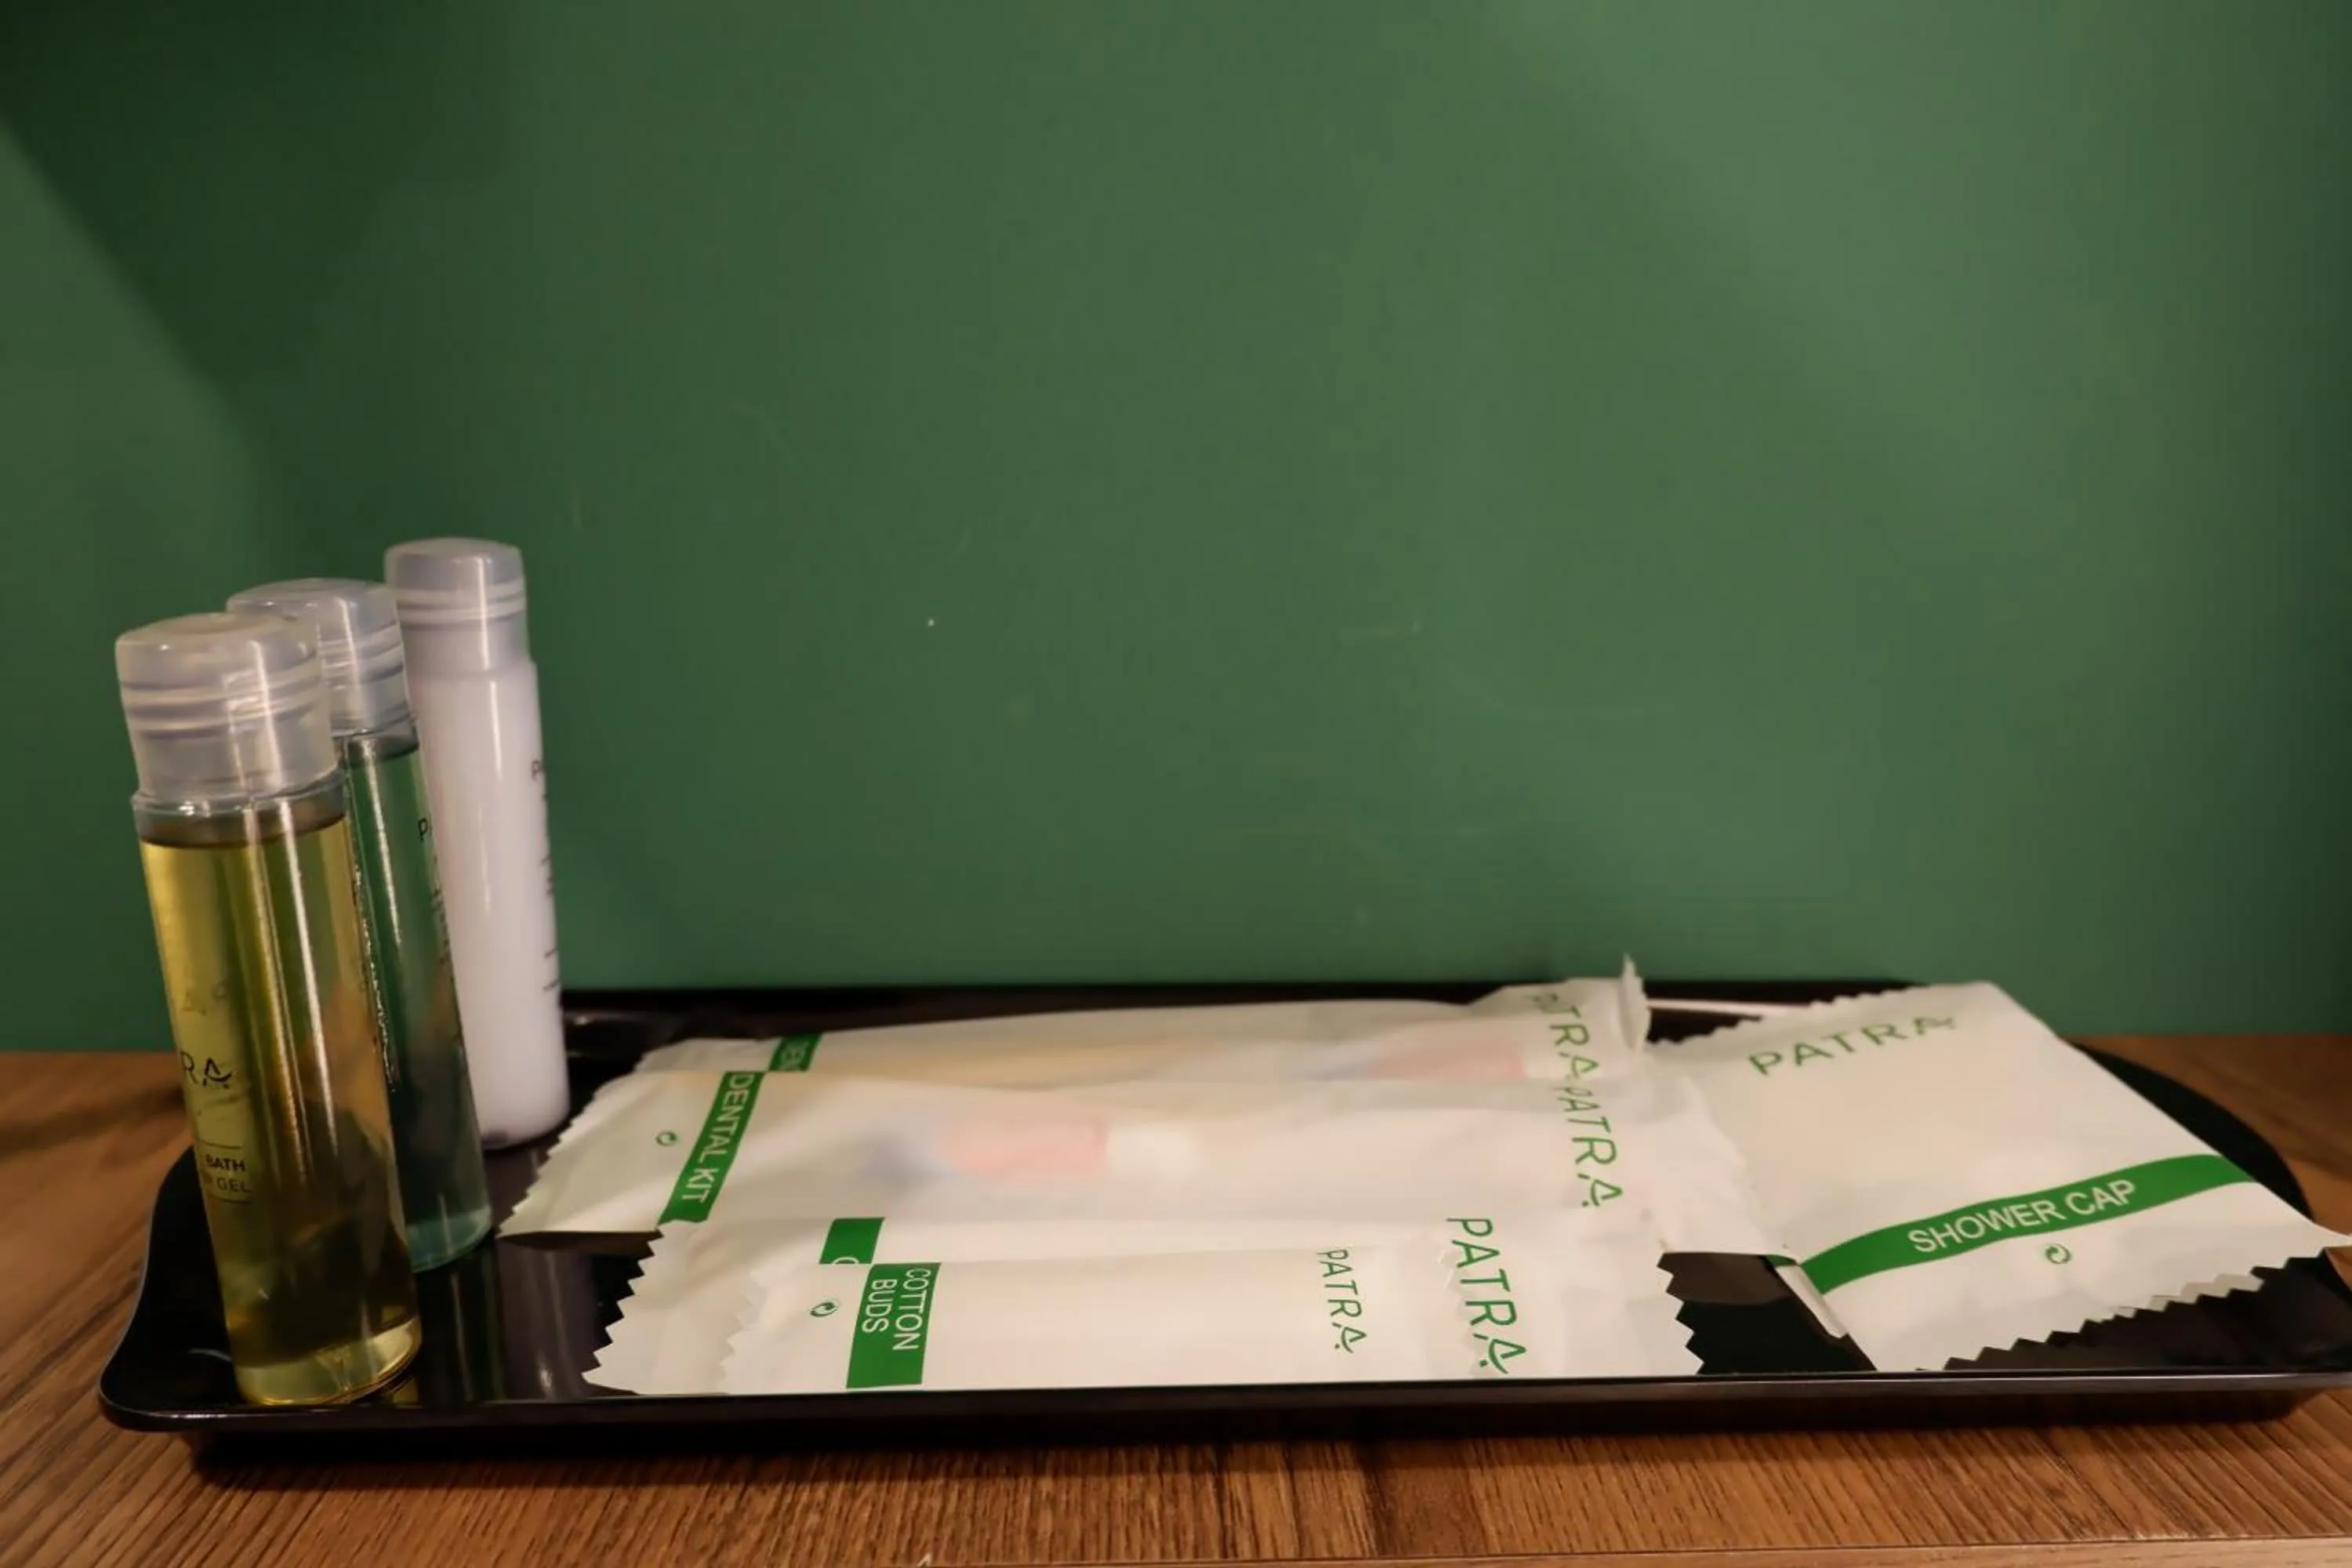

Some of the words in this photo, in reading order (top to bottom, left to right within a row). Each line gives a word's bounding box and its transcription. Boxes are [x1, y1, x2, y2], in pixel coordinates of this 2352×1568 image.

[1748, 1017, 1955, 1076] PATRA
[698, 1073, 755, 1164] DENTAL
[1552, 1087, 1624, 1207] PATRA
[681, 1167, 720, 1203] KIT
[1907, 1199, 2067, 1253] SHOWER
[2063, 1178, 2136, 1215] CAP
[862, 1278, 898, 1334] BUDS
[891, 1267, 932, 1351] COTTON
[1317, 1249, 1367, 1354] PATRA
[1446, 1218, 1527, 1374] PATRA
